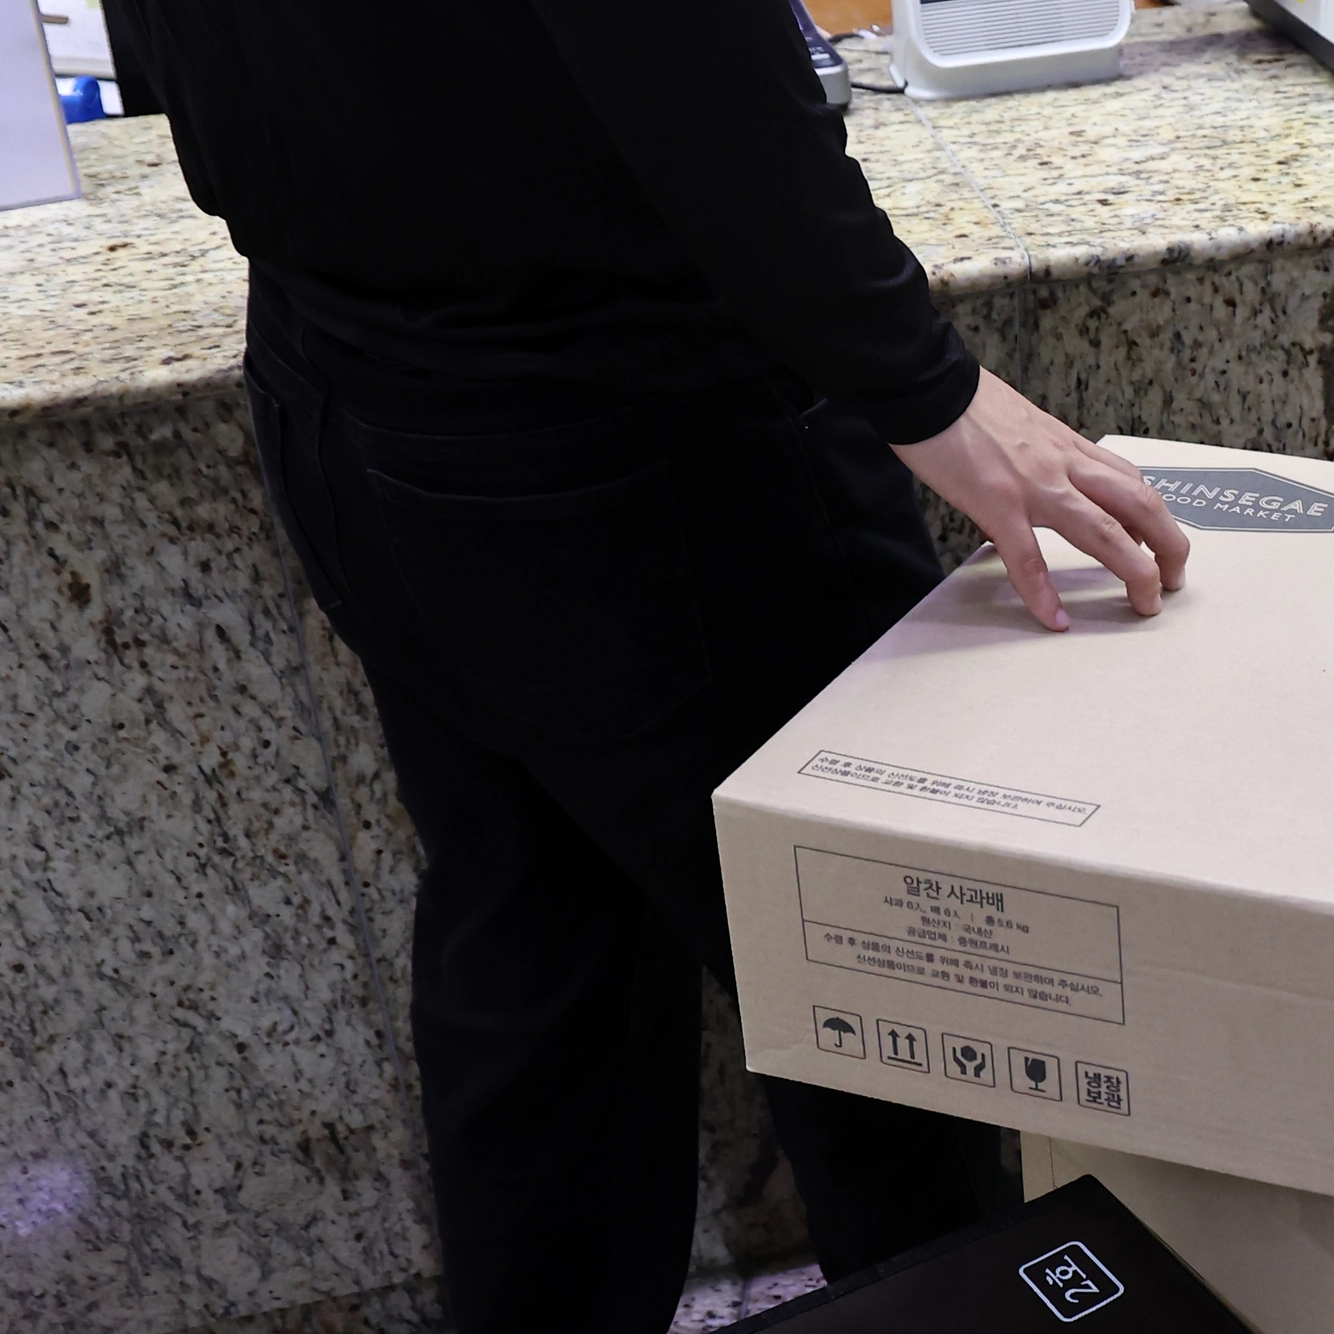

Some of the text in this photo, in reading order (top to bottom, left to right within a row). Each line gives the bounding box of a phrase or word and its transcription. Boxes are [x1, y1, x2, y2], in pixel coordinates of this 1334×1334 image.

[1142, 475, 1329, 516] SHINSEGAE
[1158, 492, 1295, 522] OOD MARKET
[902, 874, 1004, 912] 알찬 사과배
[882, 894, 904, 909] 사과
[1015, 920, 1029, 933] kg
[920, 914, 951, 931] 원산지
[962, 923, 993, 939] 국내산
[906, 925, 947, 943] 공급업체
[894, 945, 934, 963] 신선도를
[1085, 1070, 1121, 1093] 냉장
[1085, 1089, 1123, 1109] 보관
[1045, 1254, 1100, 1303] 2호
